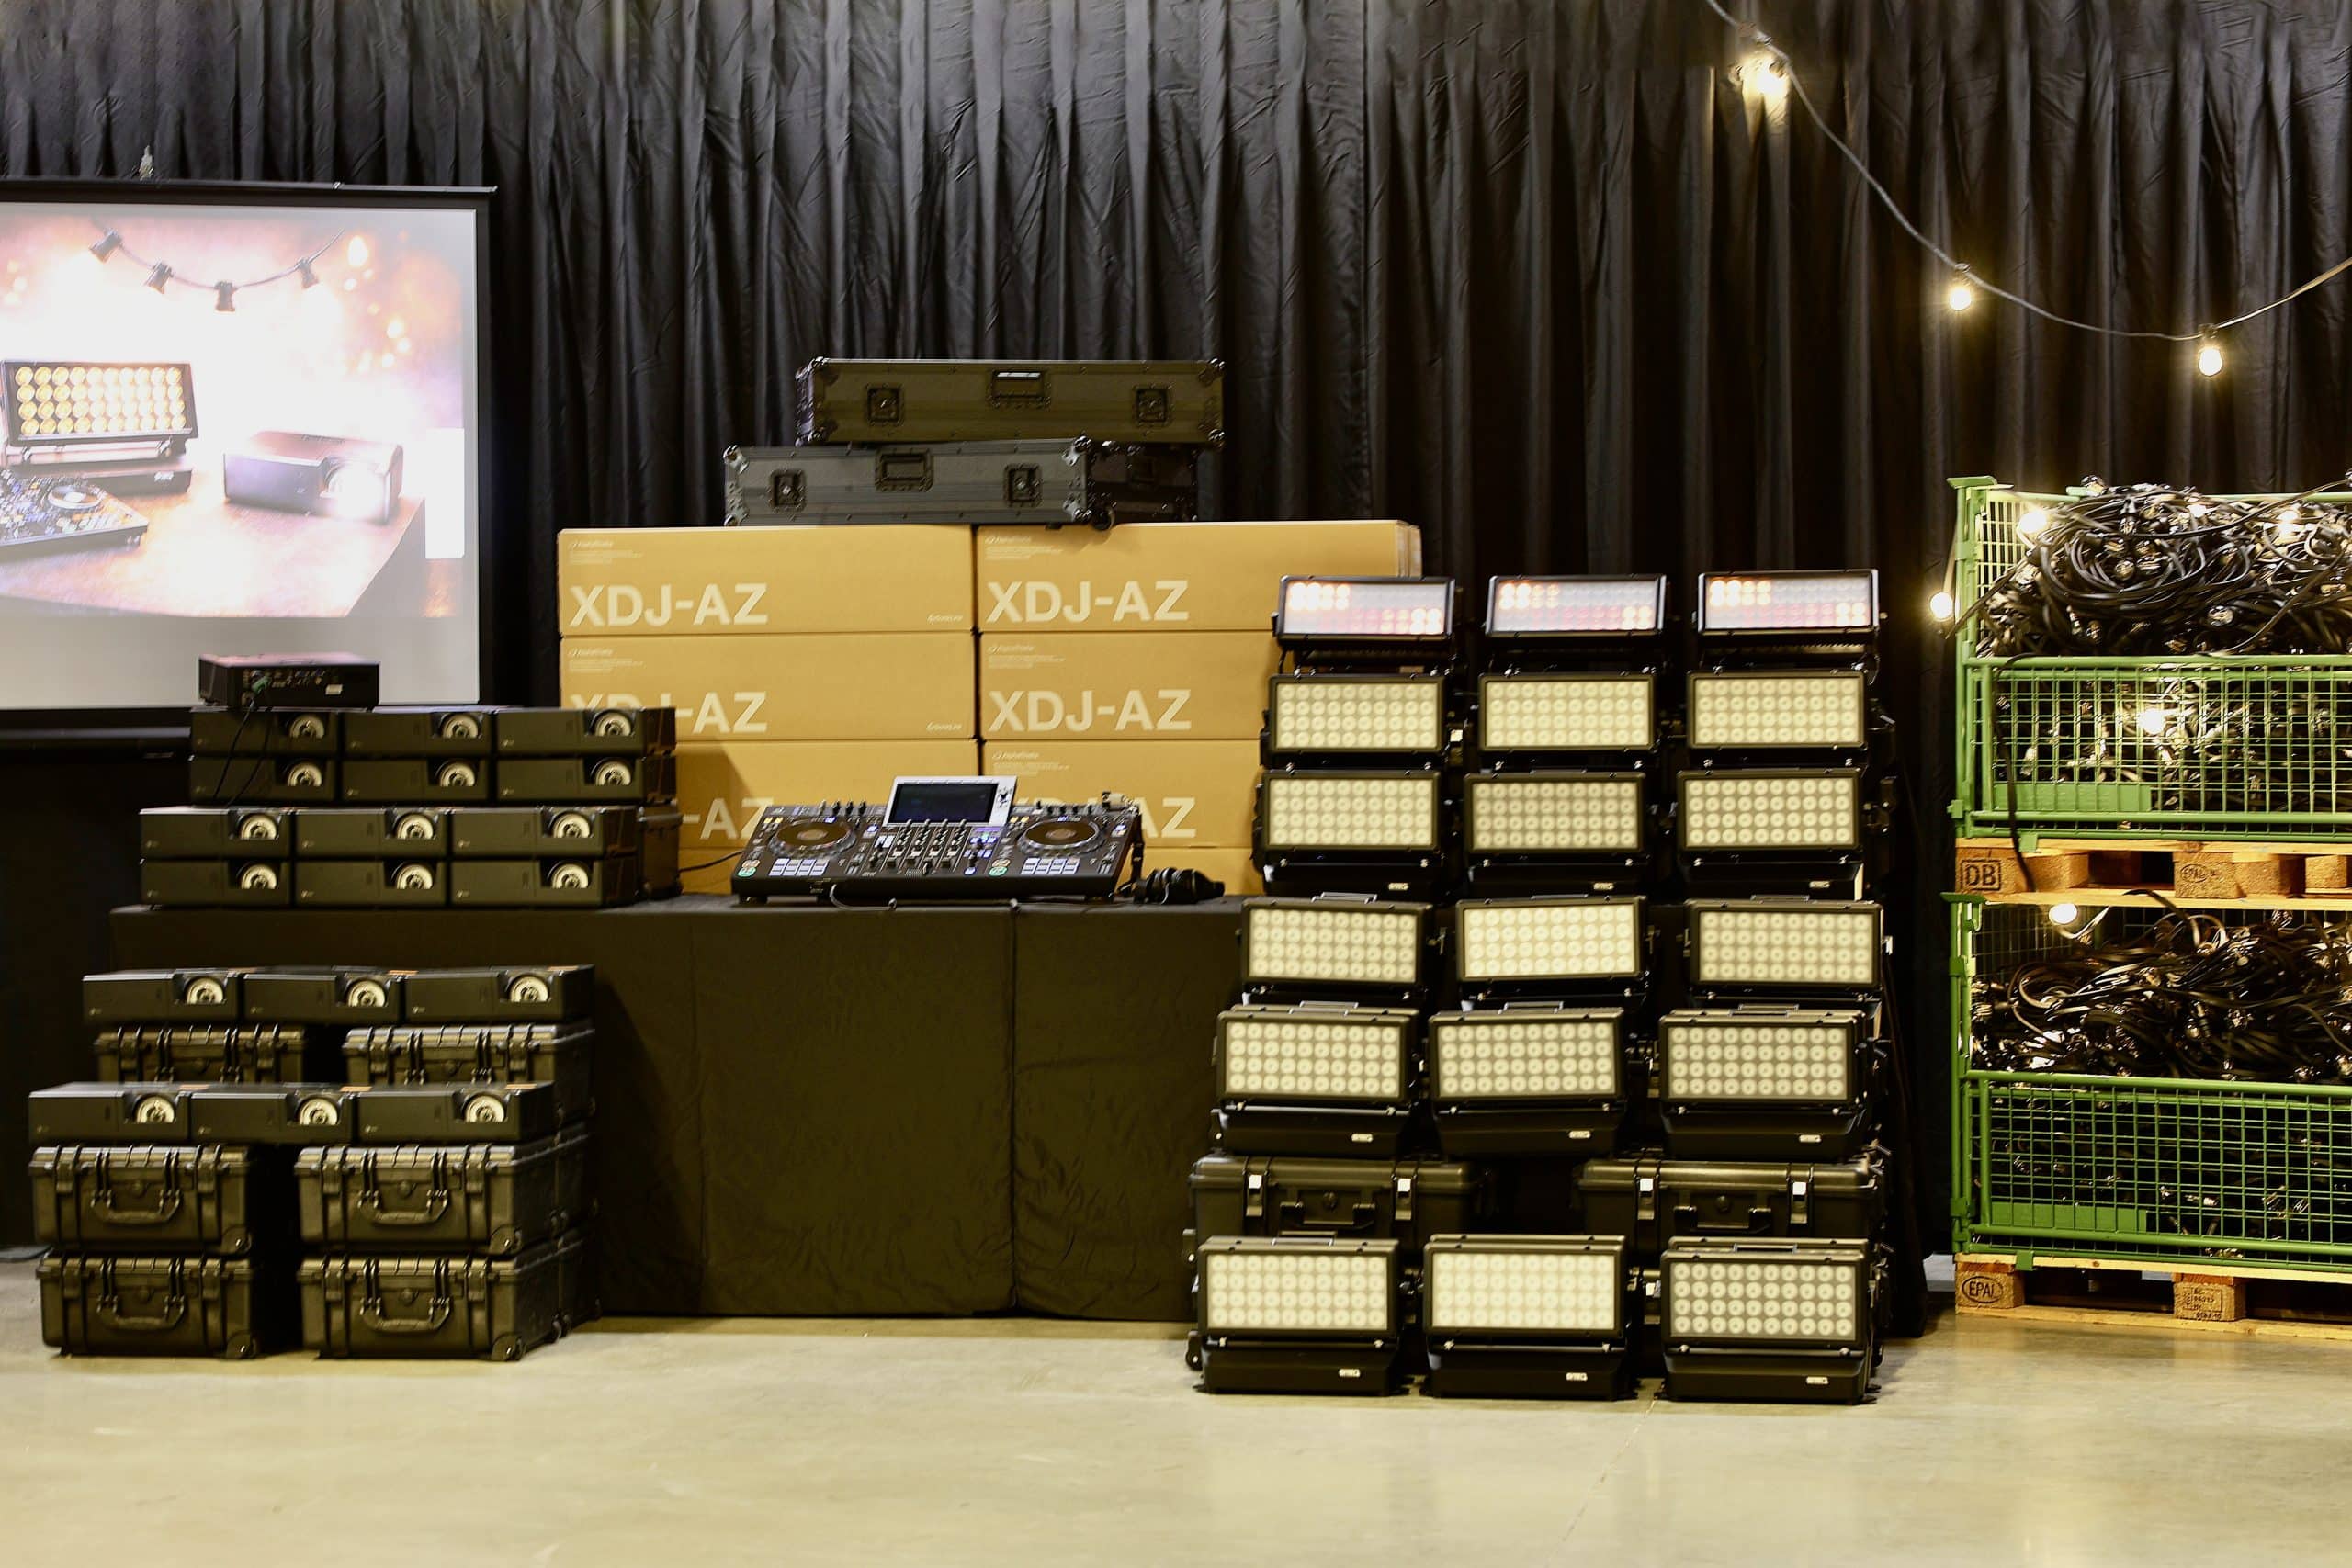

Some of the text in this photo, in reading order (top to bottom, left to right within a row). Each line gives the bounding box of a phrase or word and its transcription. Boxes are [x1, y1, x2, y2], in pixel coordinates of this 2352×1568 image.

[569, 582, 768, 627] XDJ-AZ
[986, 580, 1190, 623] XDJ-AZ
[989, 689, 1192, 732] XDJ-AZ
[1965, 863, 1997, 886] DB
